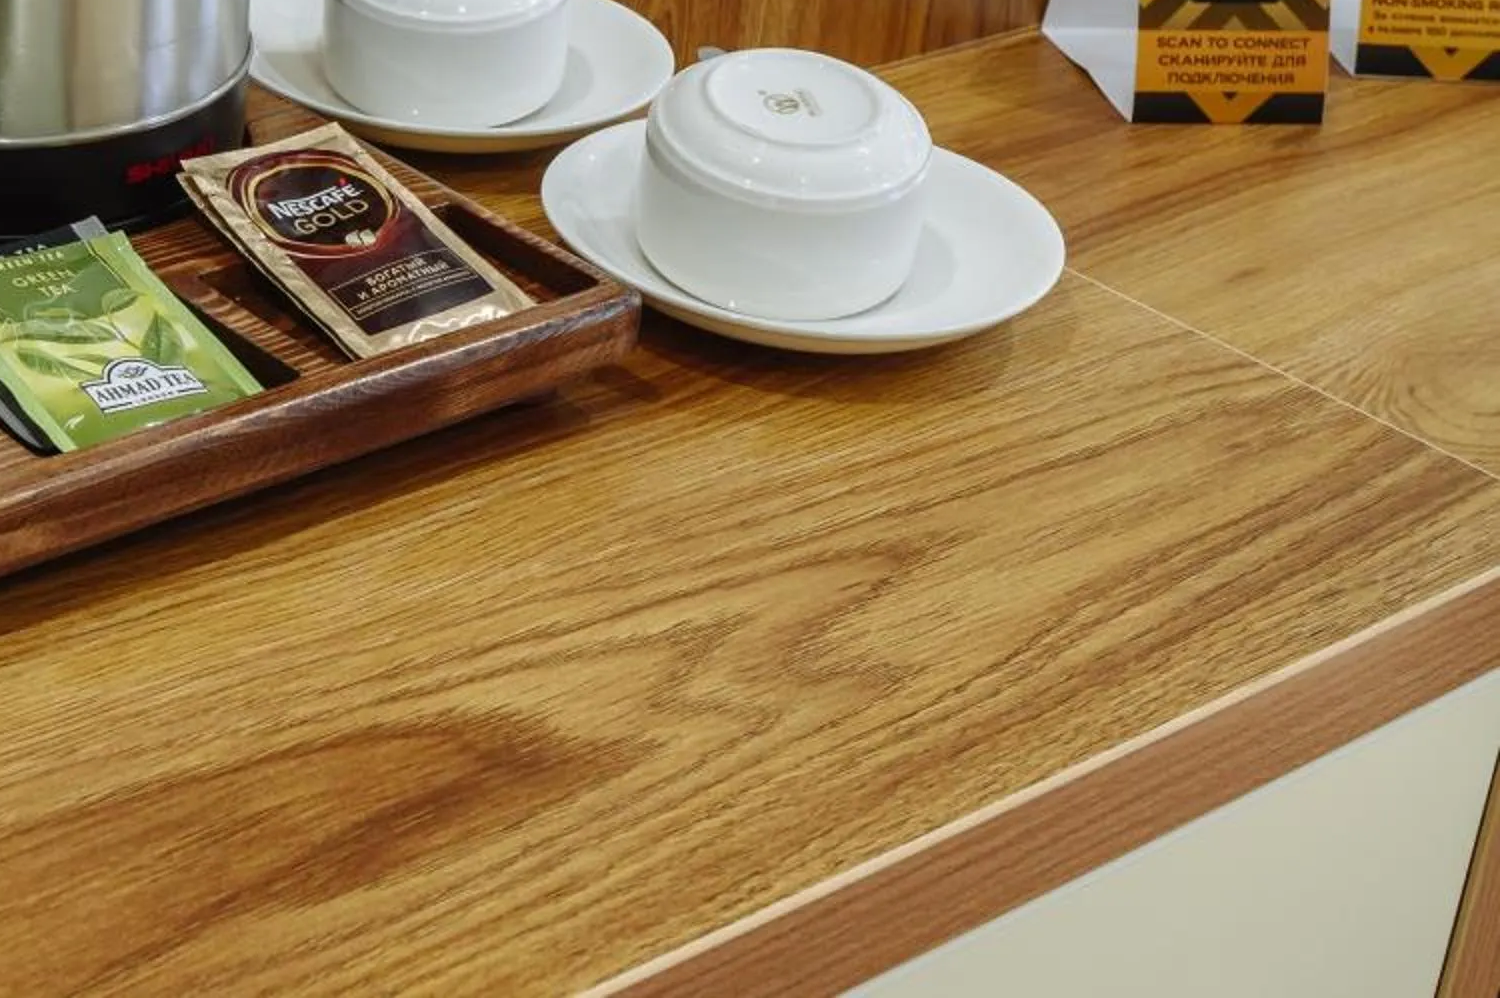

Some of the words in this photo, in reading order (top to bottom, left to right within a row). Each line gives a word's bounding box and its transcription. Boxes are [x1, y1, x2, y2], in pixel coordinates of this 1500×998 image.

[1156, 36, 1201, 49] SCAN
[1208, 37, 1229, 49] TO
[1233, 37, 1311, 50] CONNECT
[1157, 53, 1267, 67] СКАНИРУЙТЕ
[1272, 54, 1307, 68] ДЛЯ
[1167, 71, 1296, 85] ПОДКЛЮЧЕНИЯ
[267, 177, 365, 219] NESCAFÉ
[294, 199, 369, 234] GOLD
[11, 268, 77, 287] GREEN
[37, 283, 80, 298] TEA
[95, 377, 162, 402] AHMAD
[162, 373, 198, 388] TEA
